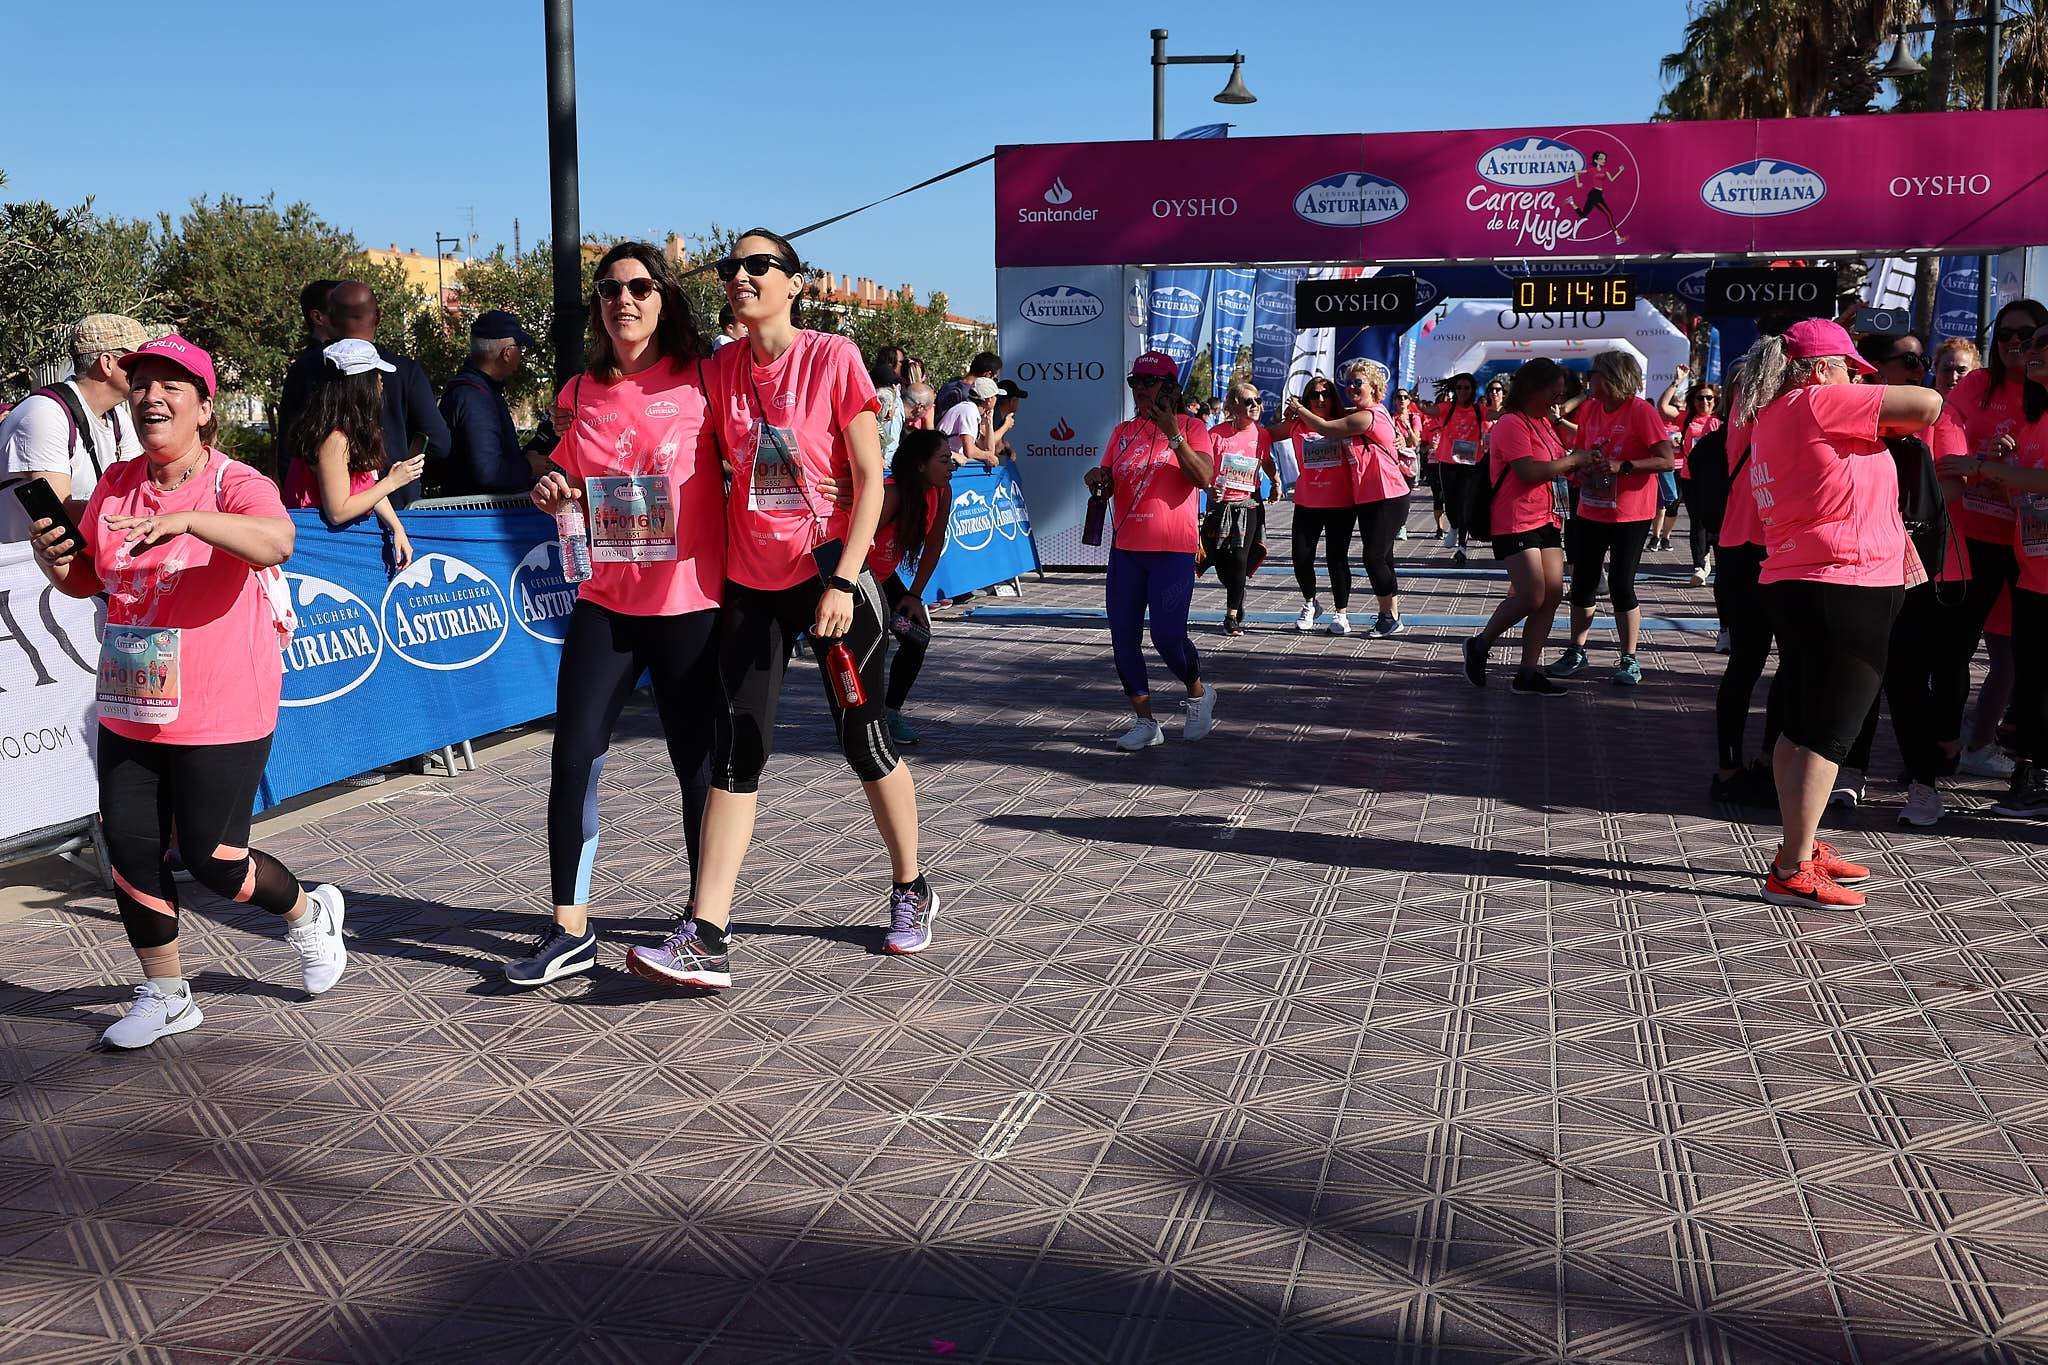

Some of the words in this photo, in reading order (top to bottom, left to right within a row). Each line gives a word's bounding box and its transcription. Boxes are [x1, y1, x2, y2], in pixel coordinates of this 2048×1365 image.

[1485, 156, 1577, 176] ASTURIANA
[1711, 181, 1815, 201] ASTURIANA
[1889, 174, 1991, 197] OYSHO
[1152, 197, 1238, 218] OYSHO
[1302, 193, 1399, 214] ASTURIANA
[1466, 185, 1556, 211] Carrera
[1018, 207, 1099, 223] Santander
[1487, 212, 1504, 231] de
[1507, 211, 1520, 231] la
[1516, 207, 1588, 251] Mujer
[1315, 293, 1399, 312] OYSHO
[1726, 283, 1818, 302] OYSHO
[1026, 301, 1098, 317] ASTURIANA
[1497, 309, 1605, 330] OYSHO
[1433, 334, 1466, 342] OYSHO
[1636, 329, 1671, 337] OYSHO
[1017, 361, 1105, 381] OYSHO
[587, 413, 617, 426] OYSHO
[1026, 444, 1099, 457] Santander
[602, 549, 628, 557] OYSHO
[409, 591, 448, 609] CENTRAL
[451, 585, 491, 601] LECHERA
[311, 607, 361, 630] LECHERA
[397, 601, 503, 649] ASTURIANA
[280, 624, 376, 674] TURIANA
